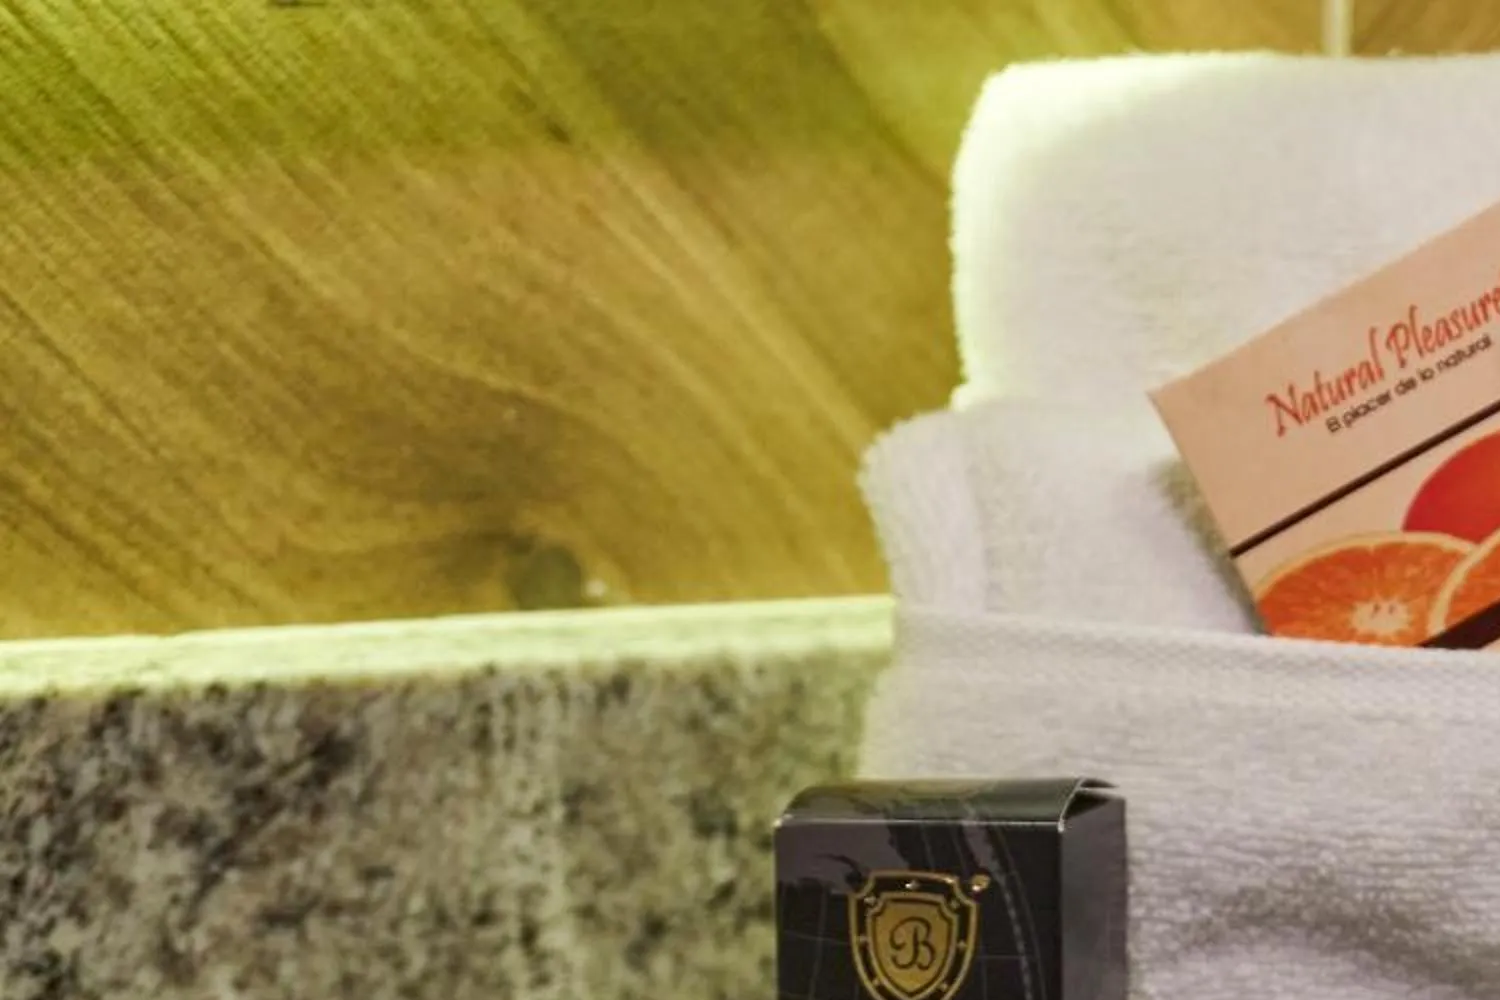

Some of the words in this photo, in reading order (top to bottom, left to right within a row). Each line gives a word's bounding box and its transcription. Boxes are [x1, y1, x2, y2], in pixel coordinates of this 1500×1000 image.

[1264, 325, 1386, 438] Natural
[1341, 388, 1393, 429] placer
[1394, 377, 1418, 396] de
[1436, 333, 1493, 373] natural
